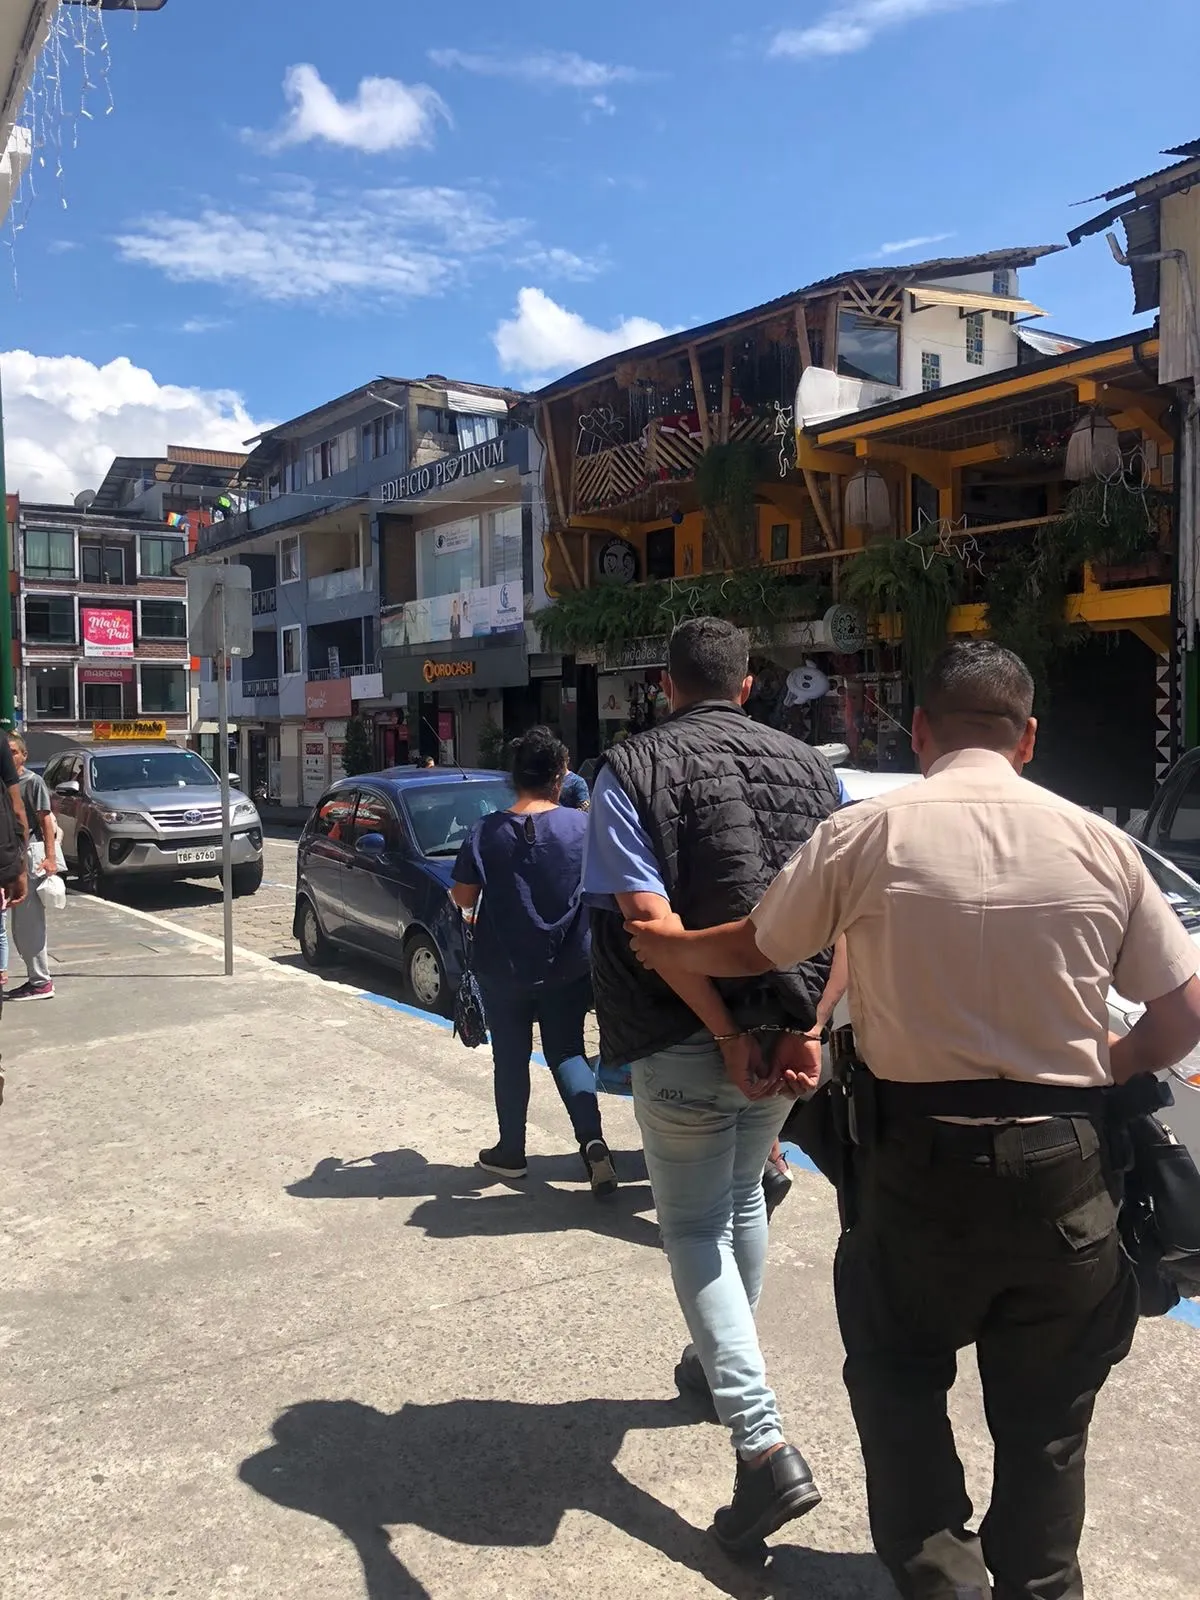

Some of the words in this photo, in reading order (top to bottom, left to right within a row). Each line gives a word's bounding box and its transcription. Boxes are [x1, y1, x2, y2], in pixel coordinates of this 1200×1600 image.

[381, 468, 430, 504] EDIFICIO
[88, 616, 120, 629] Mari
[107, 628, 129, 640] Pau
